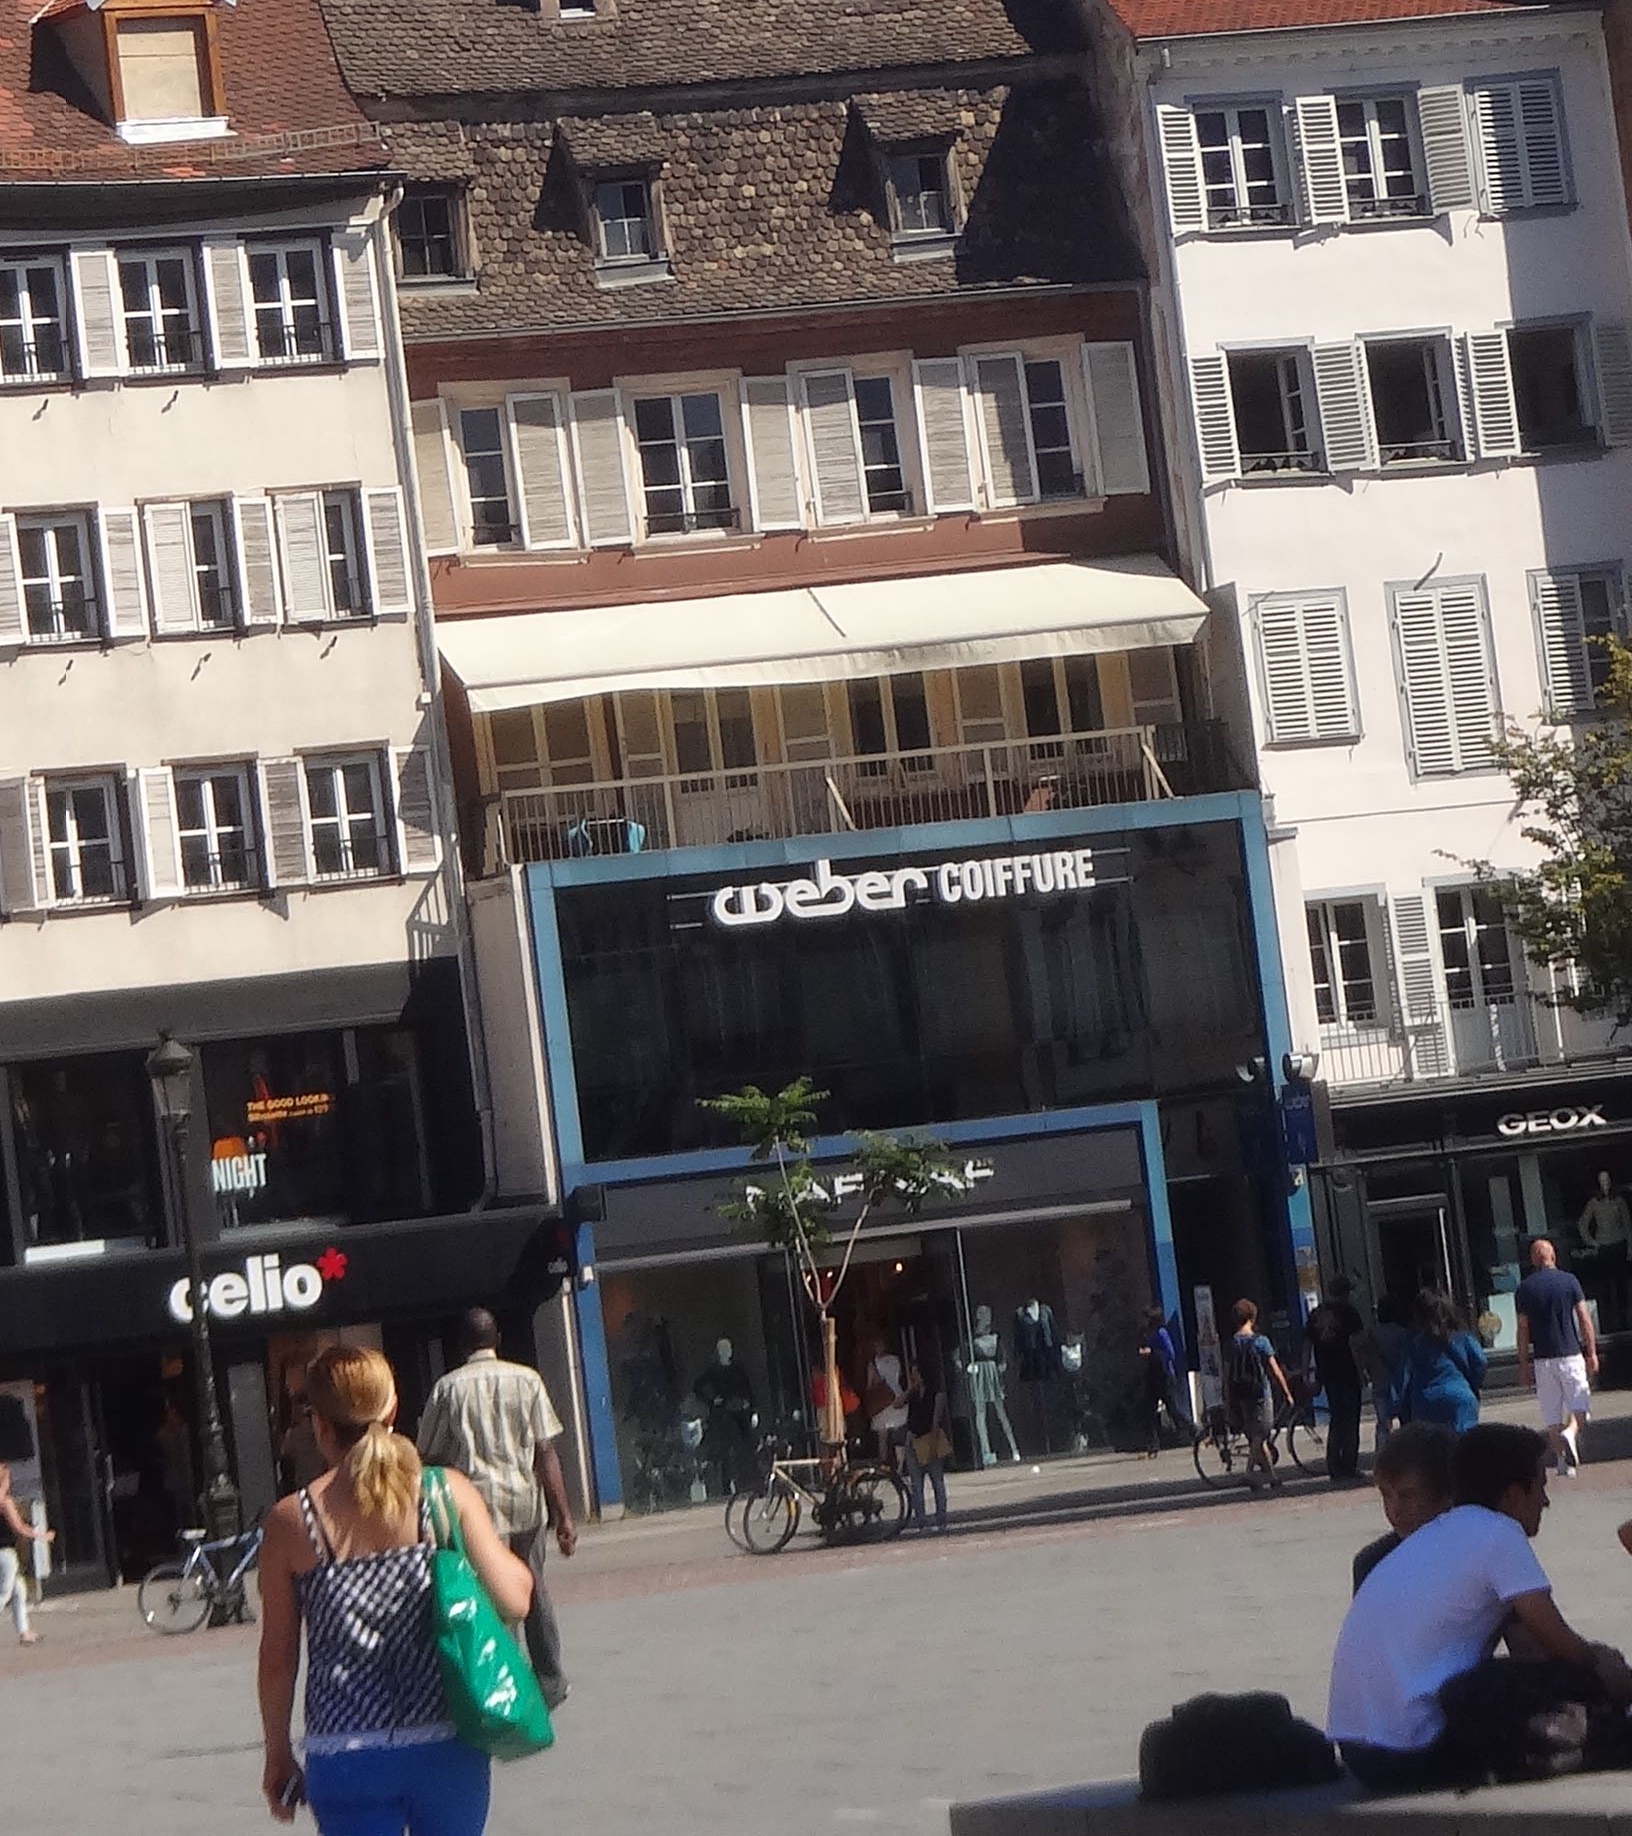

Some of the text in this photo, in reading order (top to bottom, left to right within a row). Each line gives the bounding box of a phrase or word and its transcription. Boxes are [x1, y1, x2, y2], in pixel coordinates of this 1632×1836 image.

[713, 848, 1097, 926] weber COIFFURE
[1495, 1104, 1608, 1137] GEOX
[211, 1153, 267, 1192] NIGHT
[169, 1252, 323, 1323] celio
